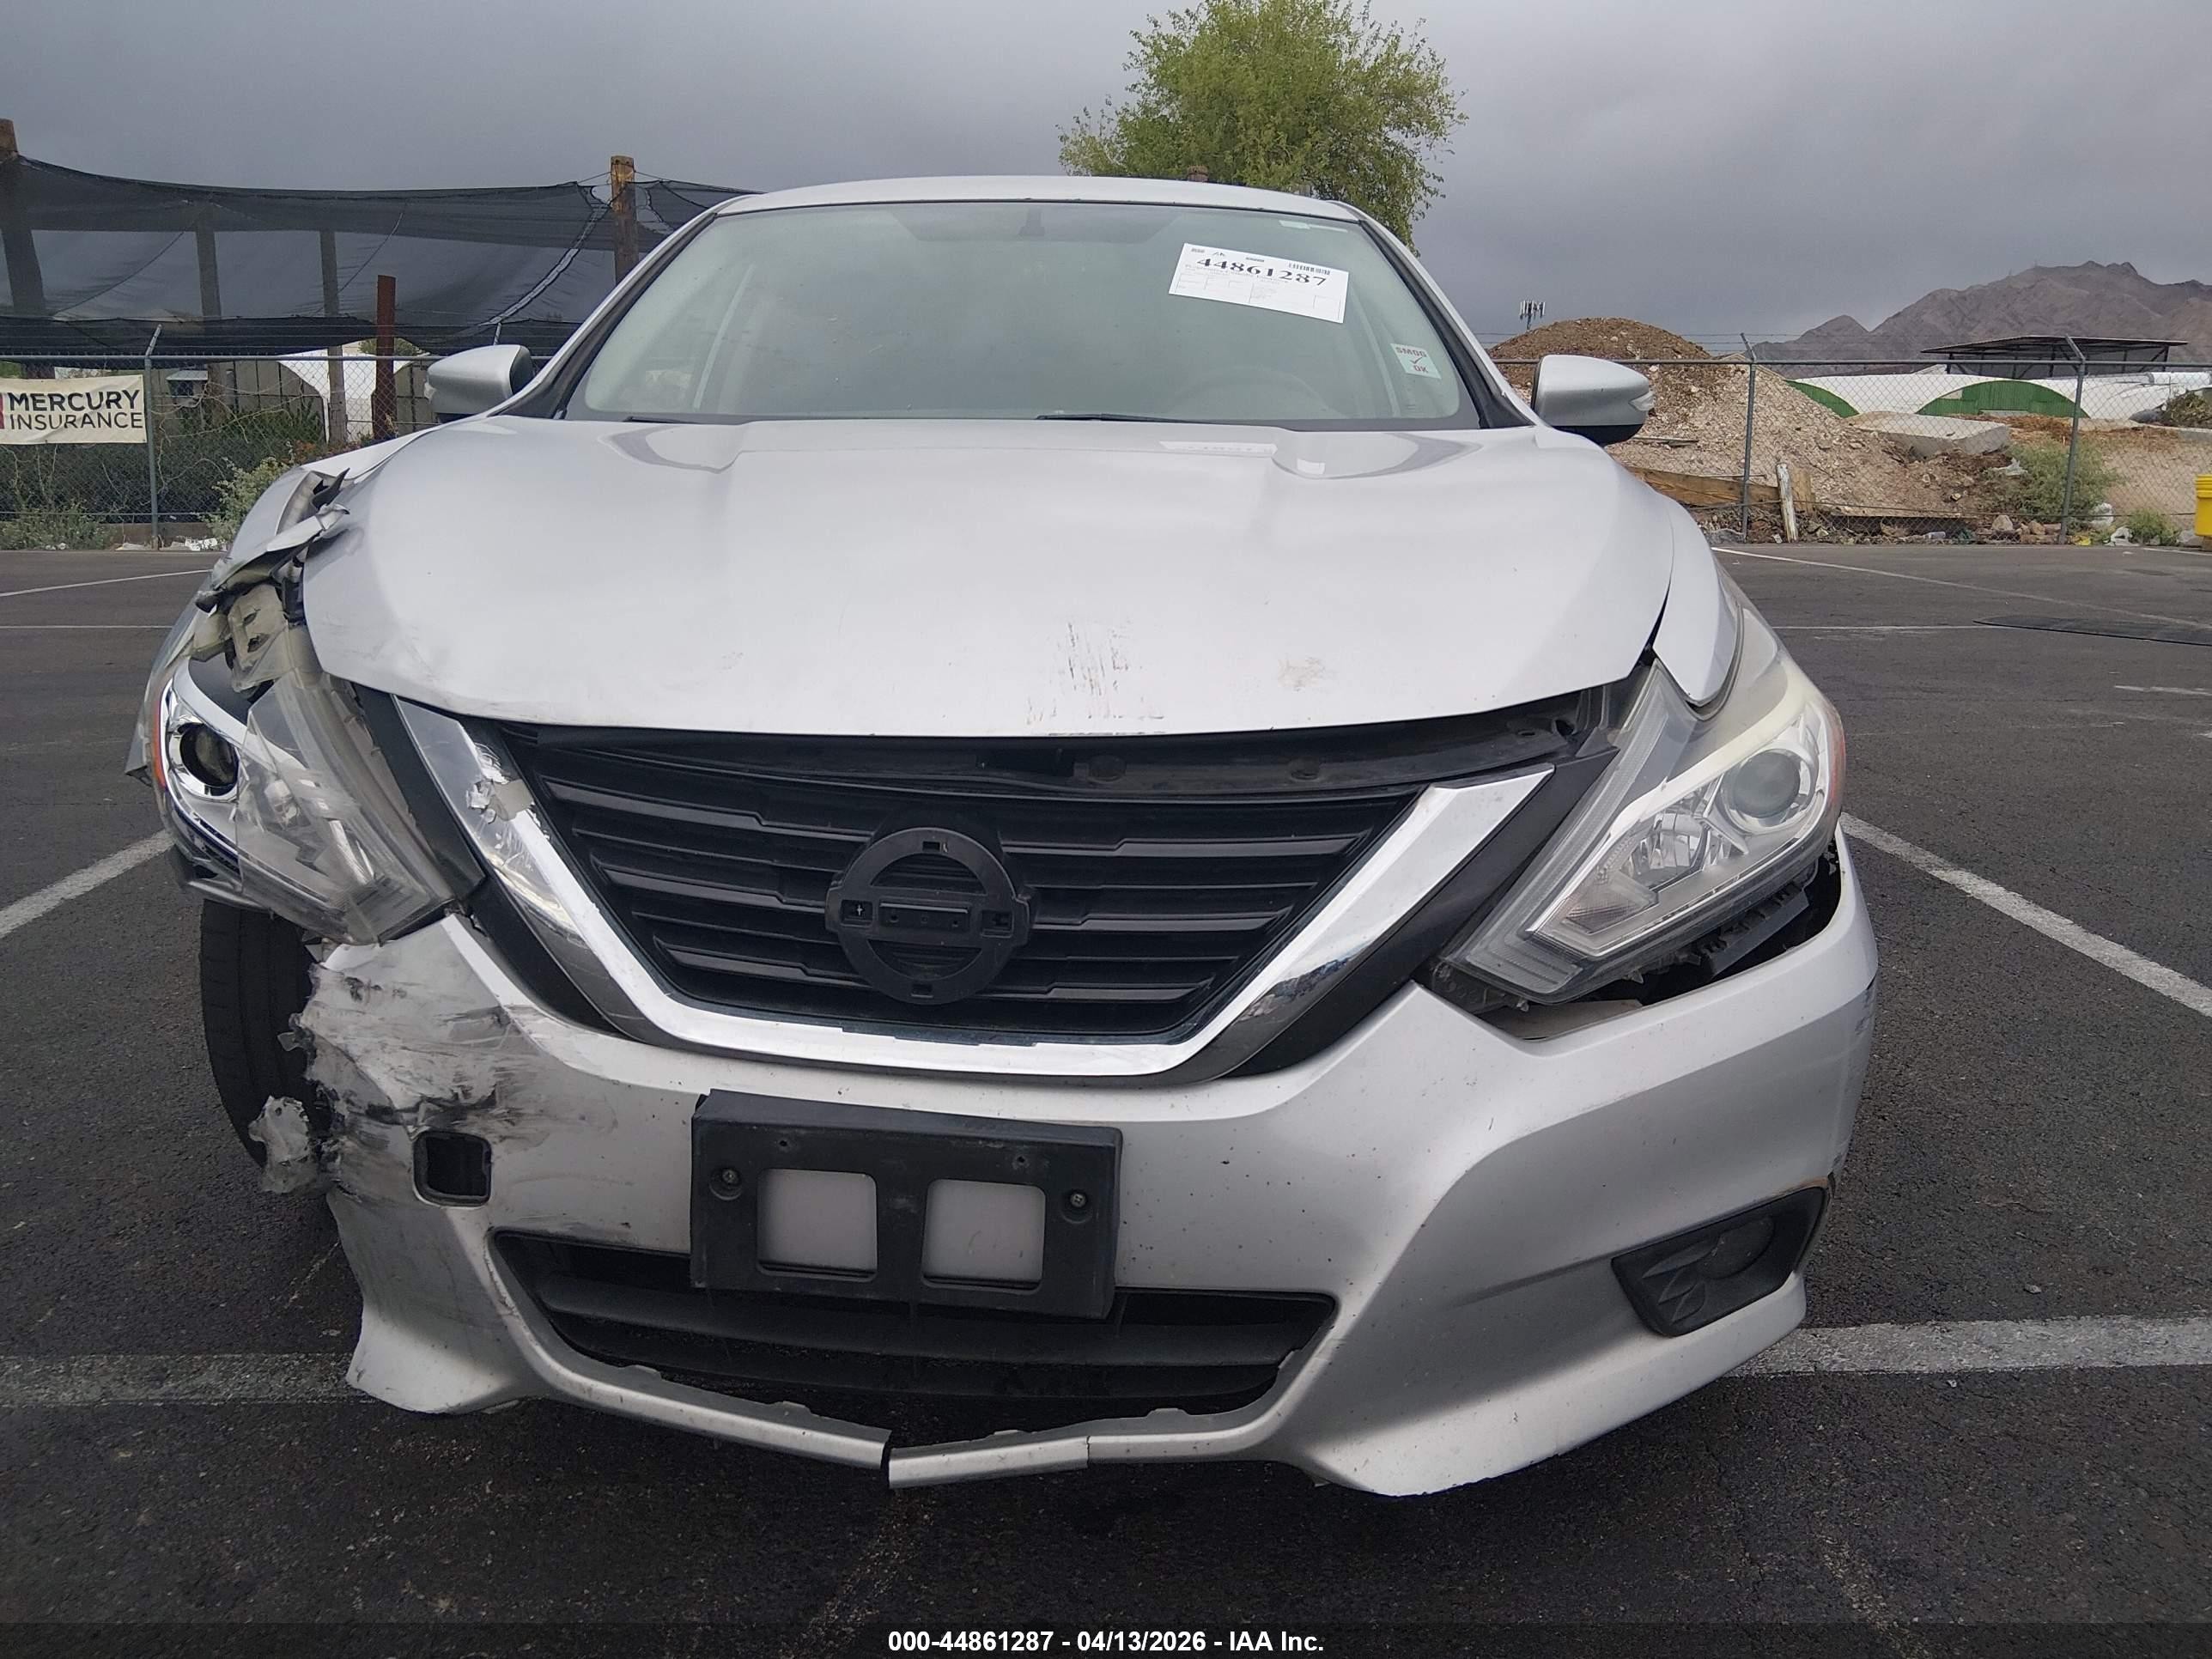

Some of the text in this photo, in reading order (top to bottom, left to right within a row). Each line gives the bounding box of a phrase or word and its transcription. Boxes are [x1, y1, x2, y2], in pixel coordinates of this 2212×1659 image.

[1197, 258, 1327, 286] 44861287
[1395, 347, 1426, 357] SMOG
[1413, 365, 1428, 374] OK
[7, 390, 139, 411] MERCURY
[10, 412, 143, 429] INSURANCE
